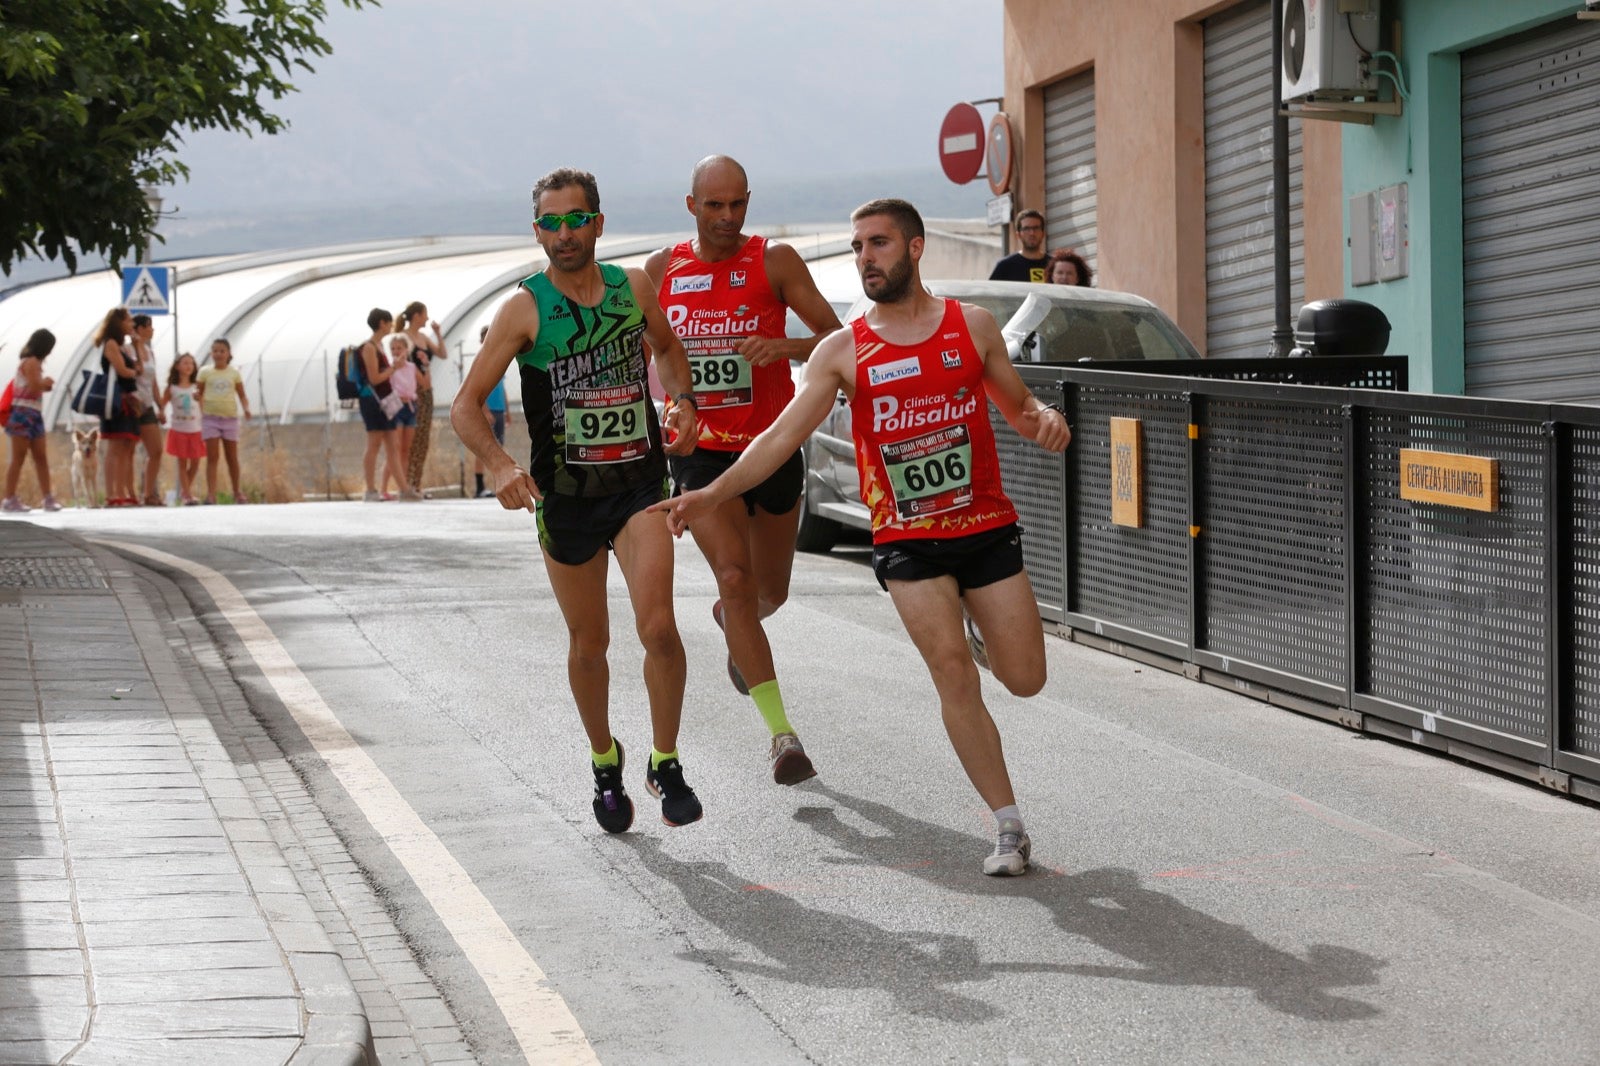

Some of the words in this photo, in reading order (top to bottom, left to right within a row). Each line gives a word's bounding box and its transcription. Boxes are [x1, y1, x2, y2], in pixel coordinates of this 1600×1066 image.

[1032, 271, 1044, 281] S
[666, 304, 760, 336] Polisalud
[692, 309, 728, 319] Clínicas
[547, 352, 592, 389] TEAM
[690, 359, 739, 386] 589
[944, 358, 961, 367] MOVE
[585, 390, 600, 400] GRAN
[601, 388, 620, 399] PREMIO
[621, 387, 628, 397] DE
[904, 393, 946, 409] Clínicas
[581, 408, 636, 440] 929
[872, 395, 976, 433] Polisalud
[900, 442, 916, 453] GRAN
[916, 435, 937, 449] PREMIO
[936, 433, 945, 442] DE
[904, 452, 966, 492] 606
[1407, 462, 1441, 491] CERVEZAS
[1443, 468, 1483, 497] ALHAMBRA
